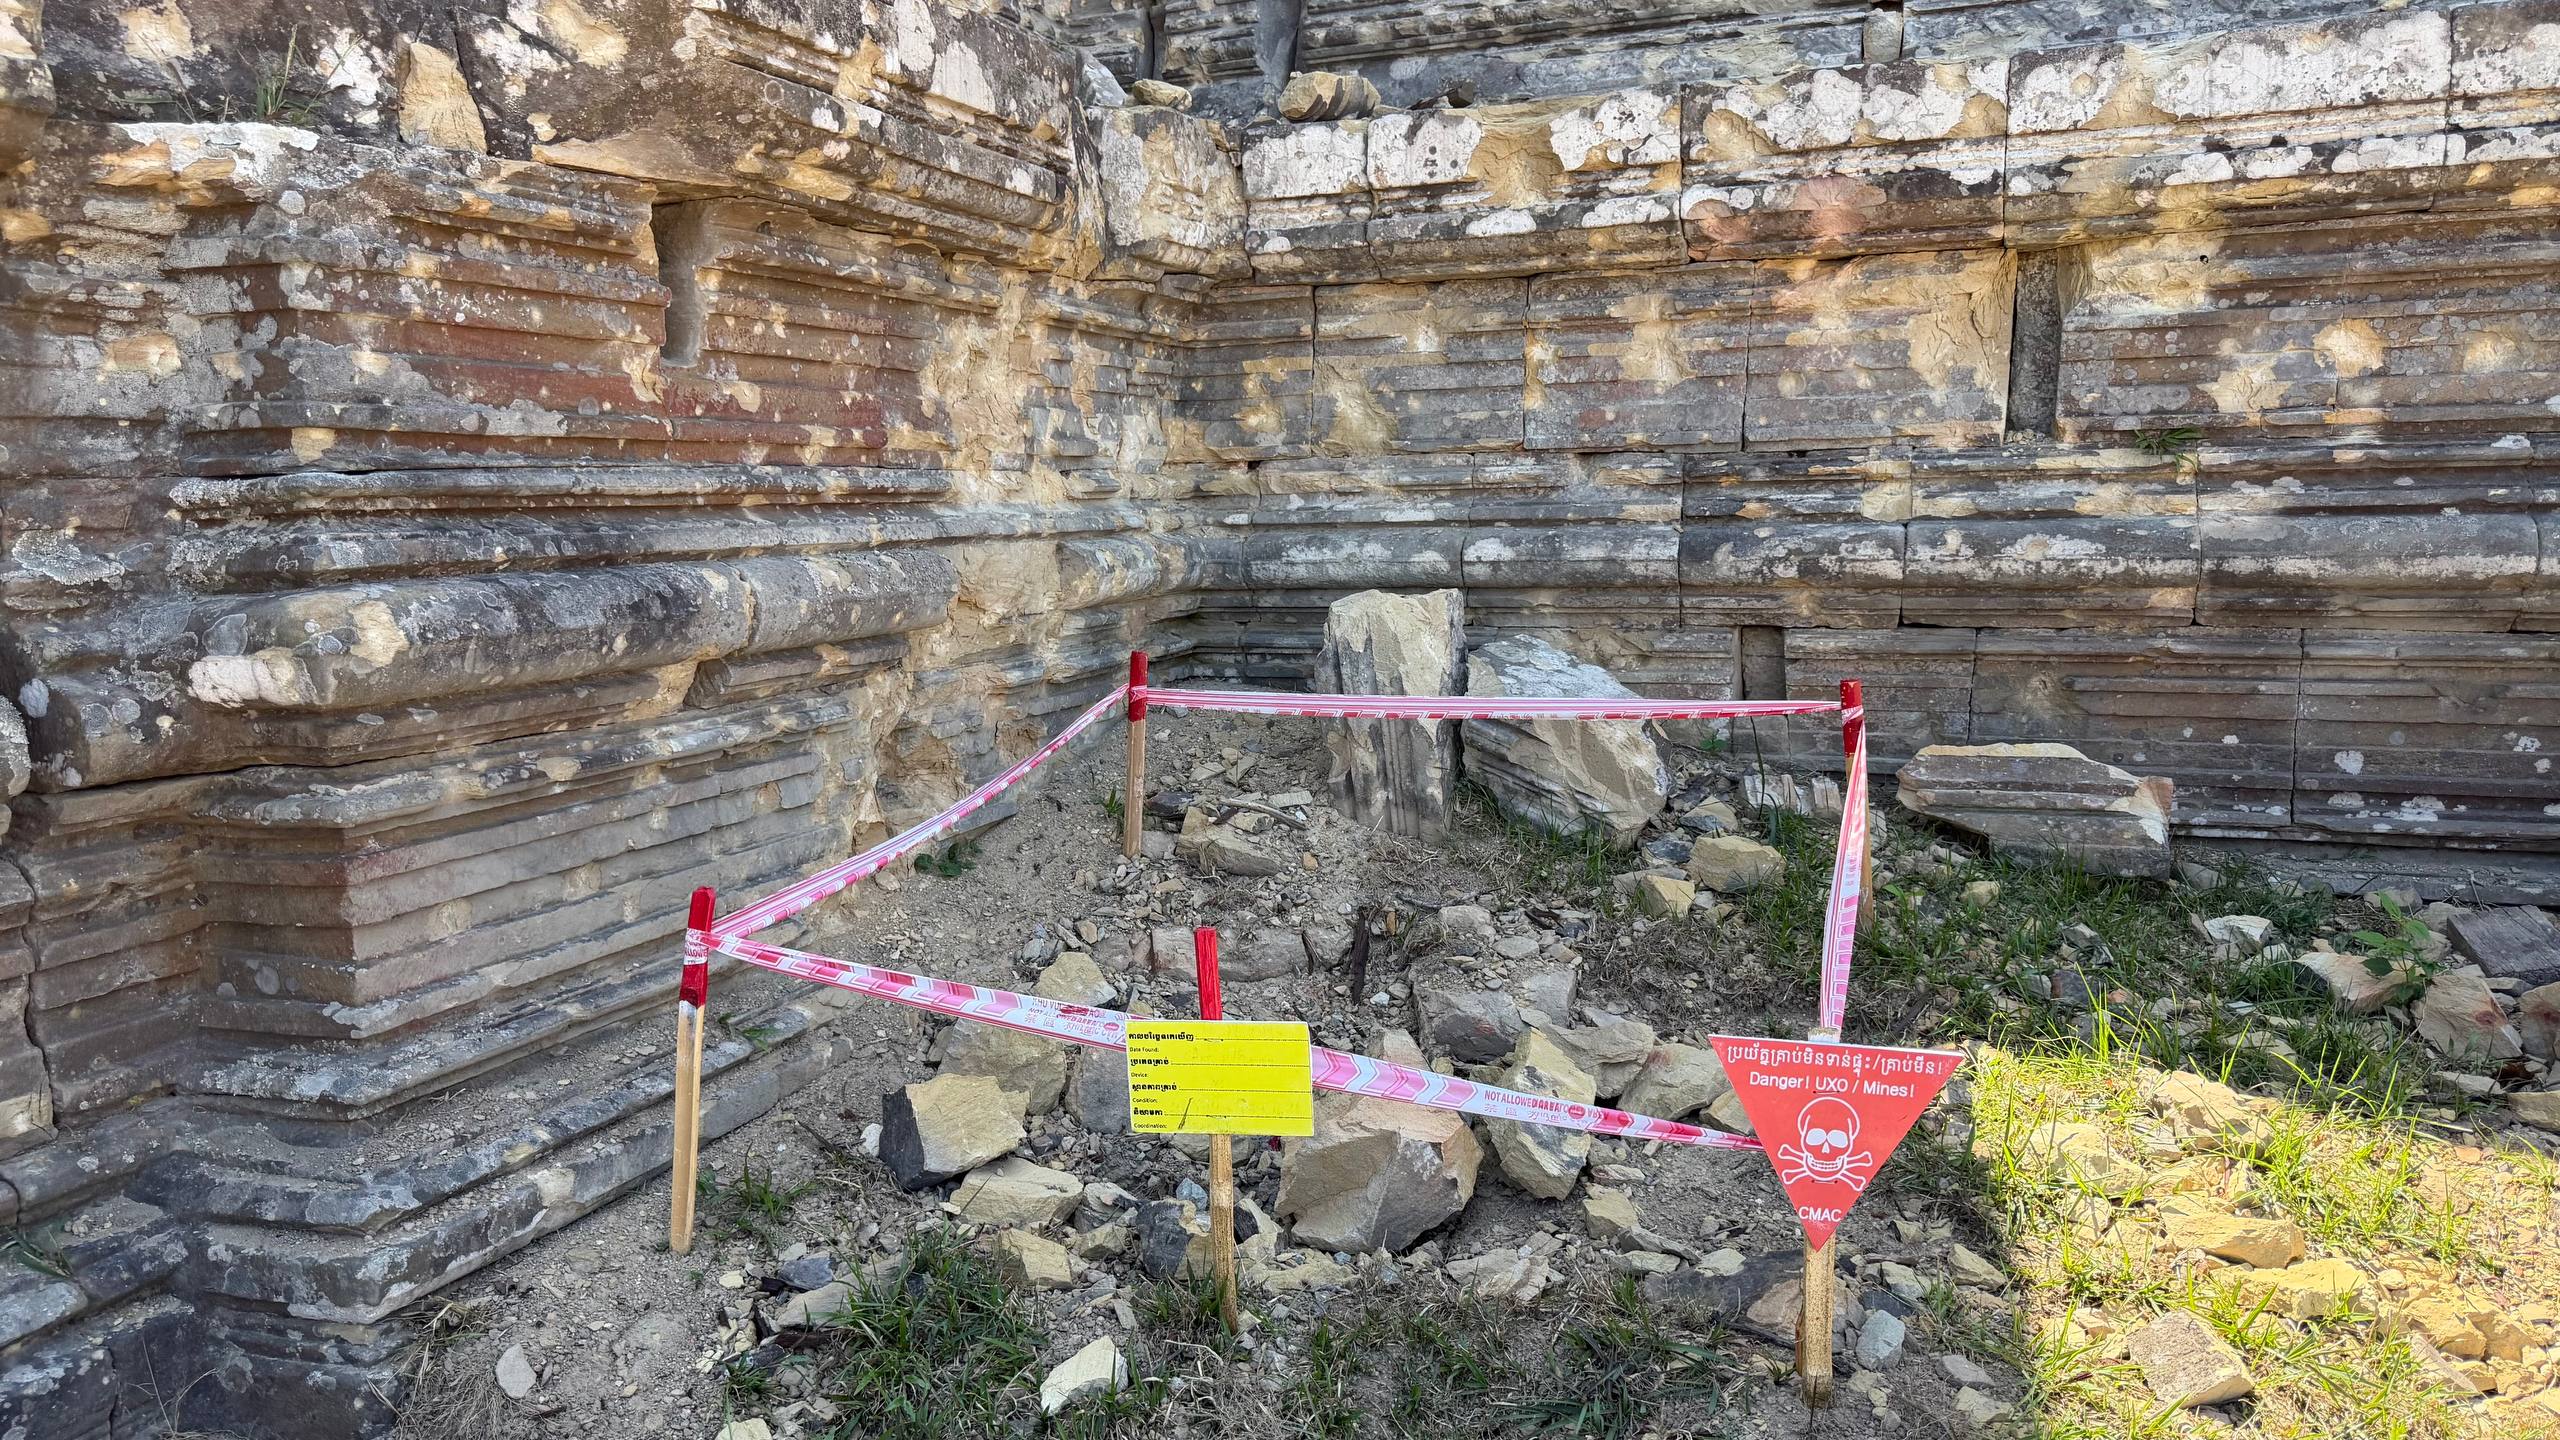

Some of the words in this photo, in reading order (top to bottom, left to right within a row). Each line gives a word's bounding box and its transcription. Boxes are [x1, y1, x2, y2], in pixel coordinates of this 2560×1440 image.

[1749, 1072, 1809, 1090] Danger!
[1815, 1076, 1848, 1092] UXO
[1852, 1080, 1859, 1094] /
[1863, 1079, 1914, 1098] Mines!
[1484, 1089, 1500, 1102] NOT
[1798, 1206, 1842, 1222] CMAC
